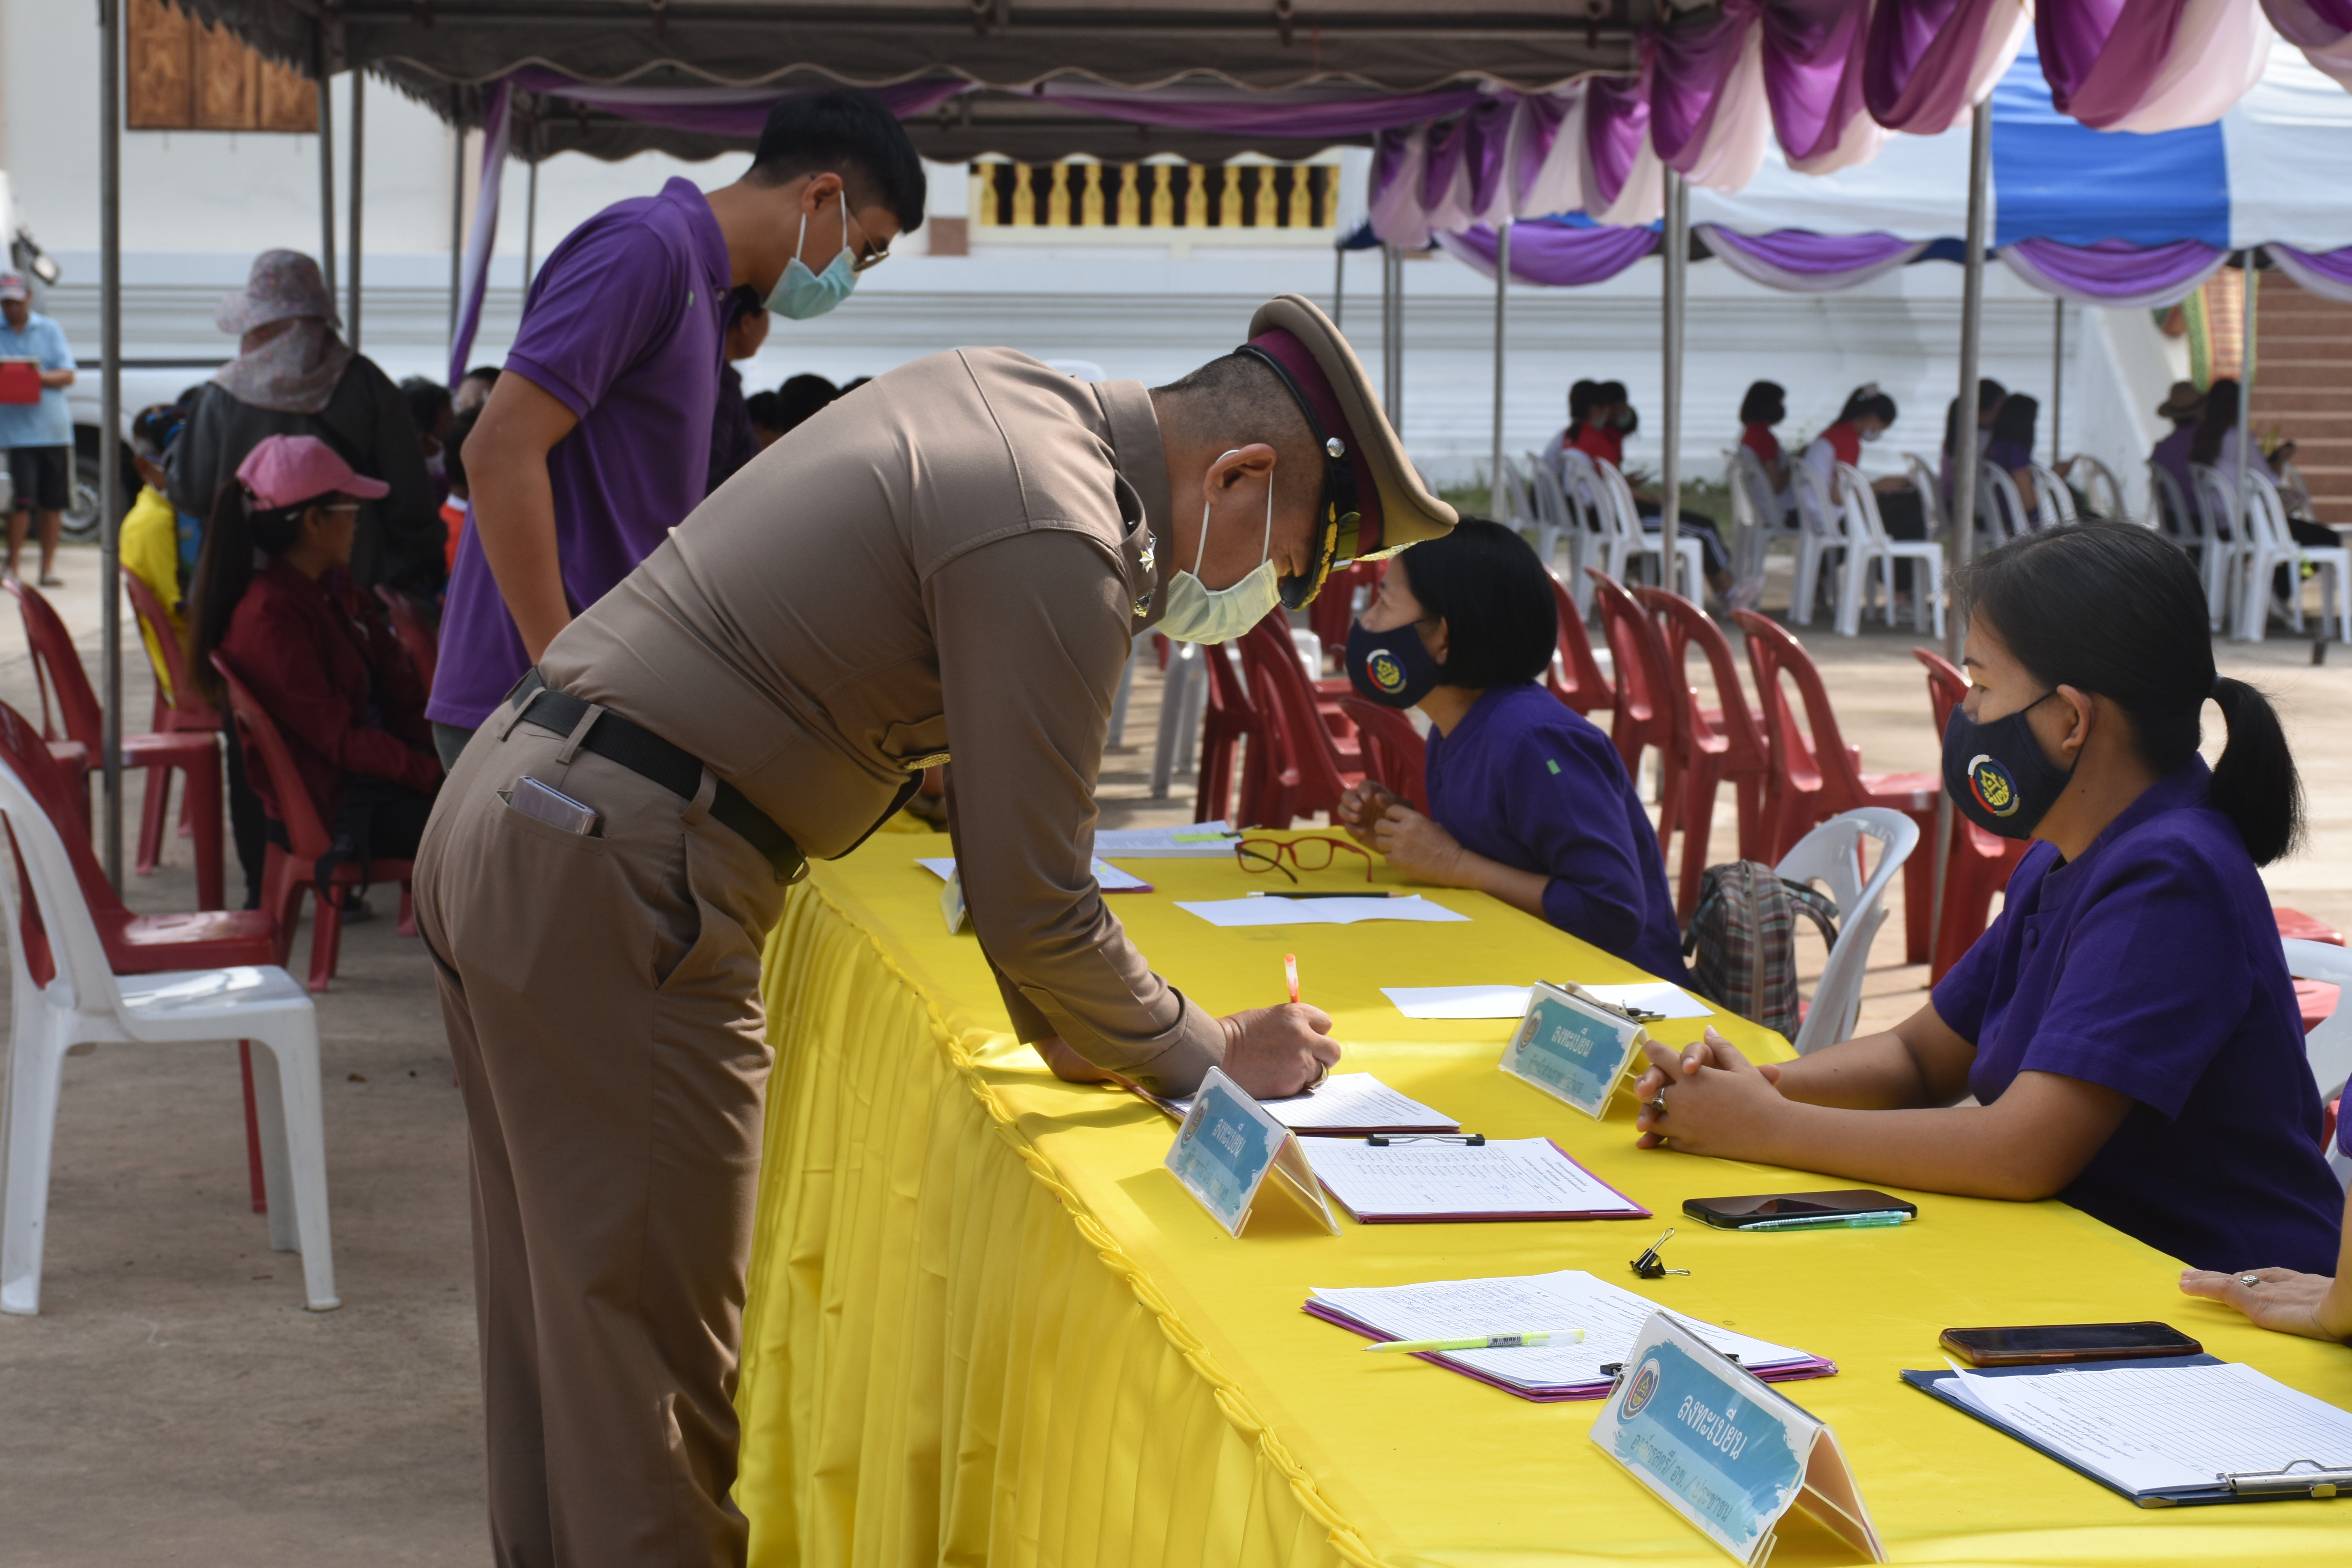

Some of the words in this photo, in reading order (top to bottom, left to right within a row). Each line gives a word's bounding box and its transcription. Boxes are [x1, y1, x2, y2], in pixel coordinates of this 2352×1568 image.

[1552, 1026, 1594, 1057] ลงทะเบียน
[1212, 1118, 1246, 1157] ลงทะเบียน
[1677, 1395, 1748, 1460] ลงทะเบียน
[1670, 1466, 1687, 1488] อช.
[1692, 1479, 1733, 1522] ประชาชน
